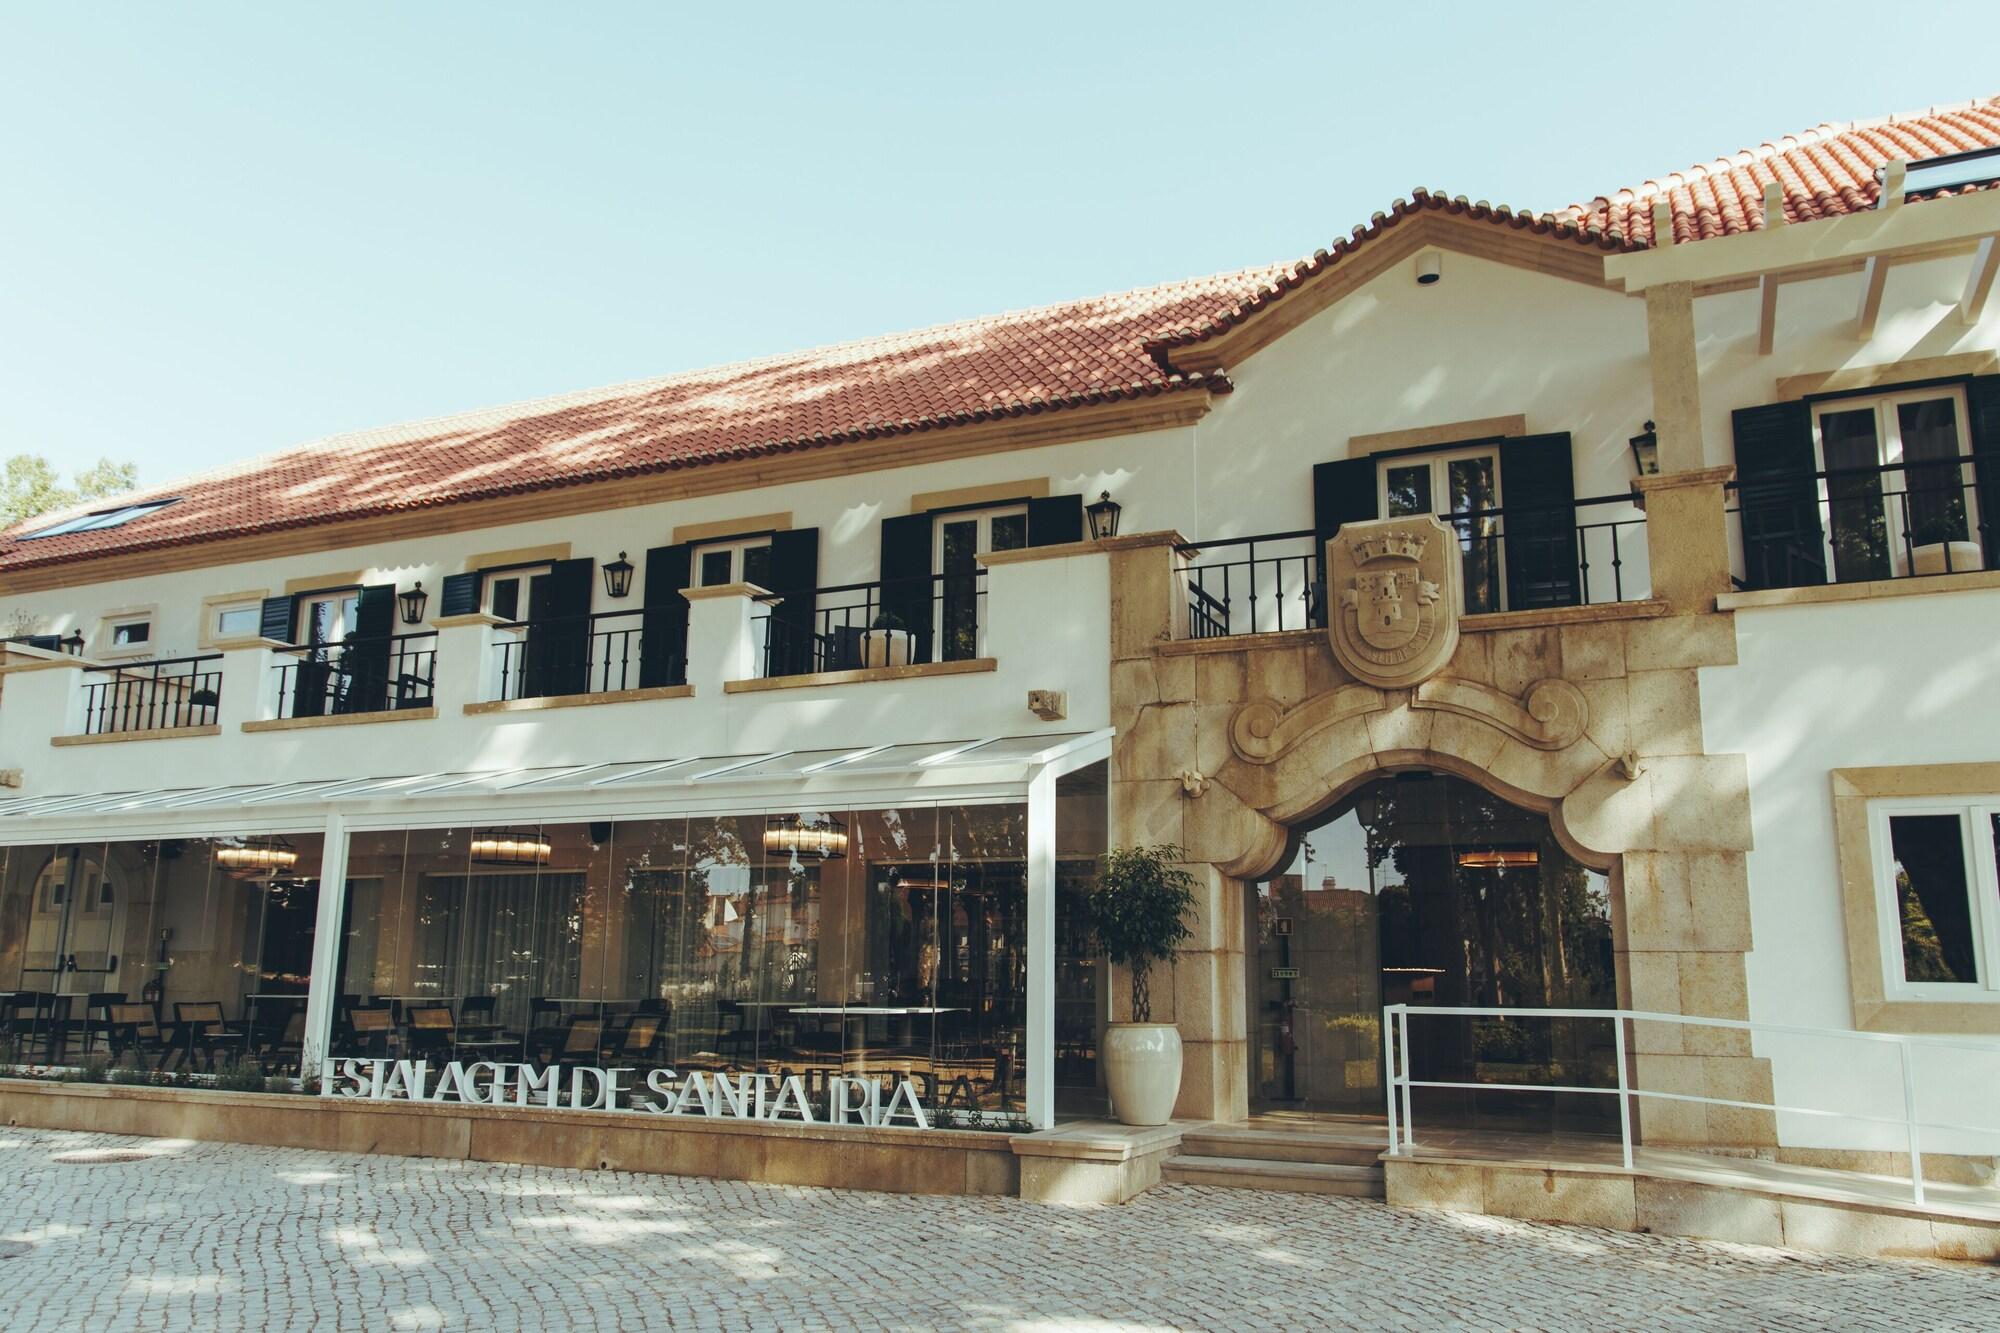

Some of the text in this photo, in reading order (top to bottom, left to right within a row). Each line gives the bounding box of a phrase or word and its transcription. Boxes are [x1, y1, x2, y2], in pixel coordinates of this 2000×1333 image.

[570, 1066, 636, 1112] DE
[645, 1068, 815, 1123] SANTA
[830, 1077, 935, 1130] IRIA
